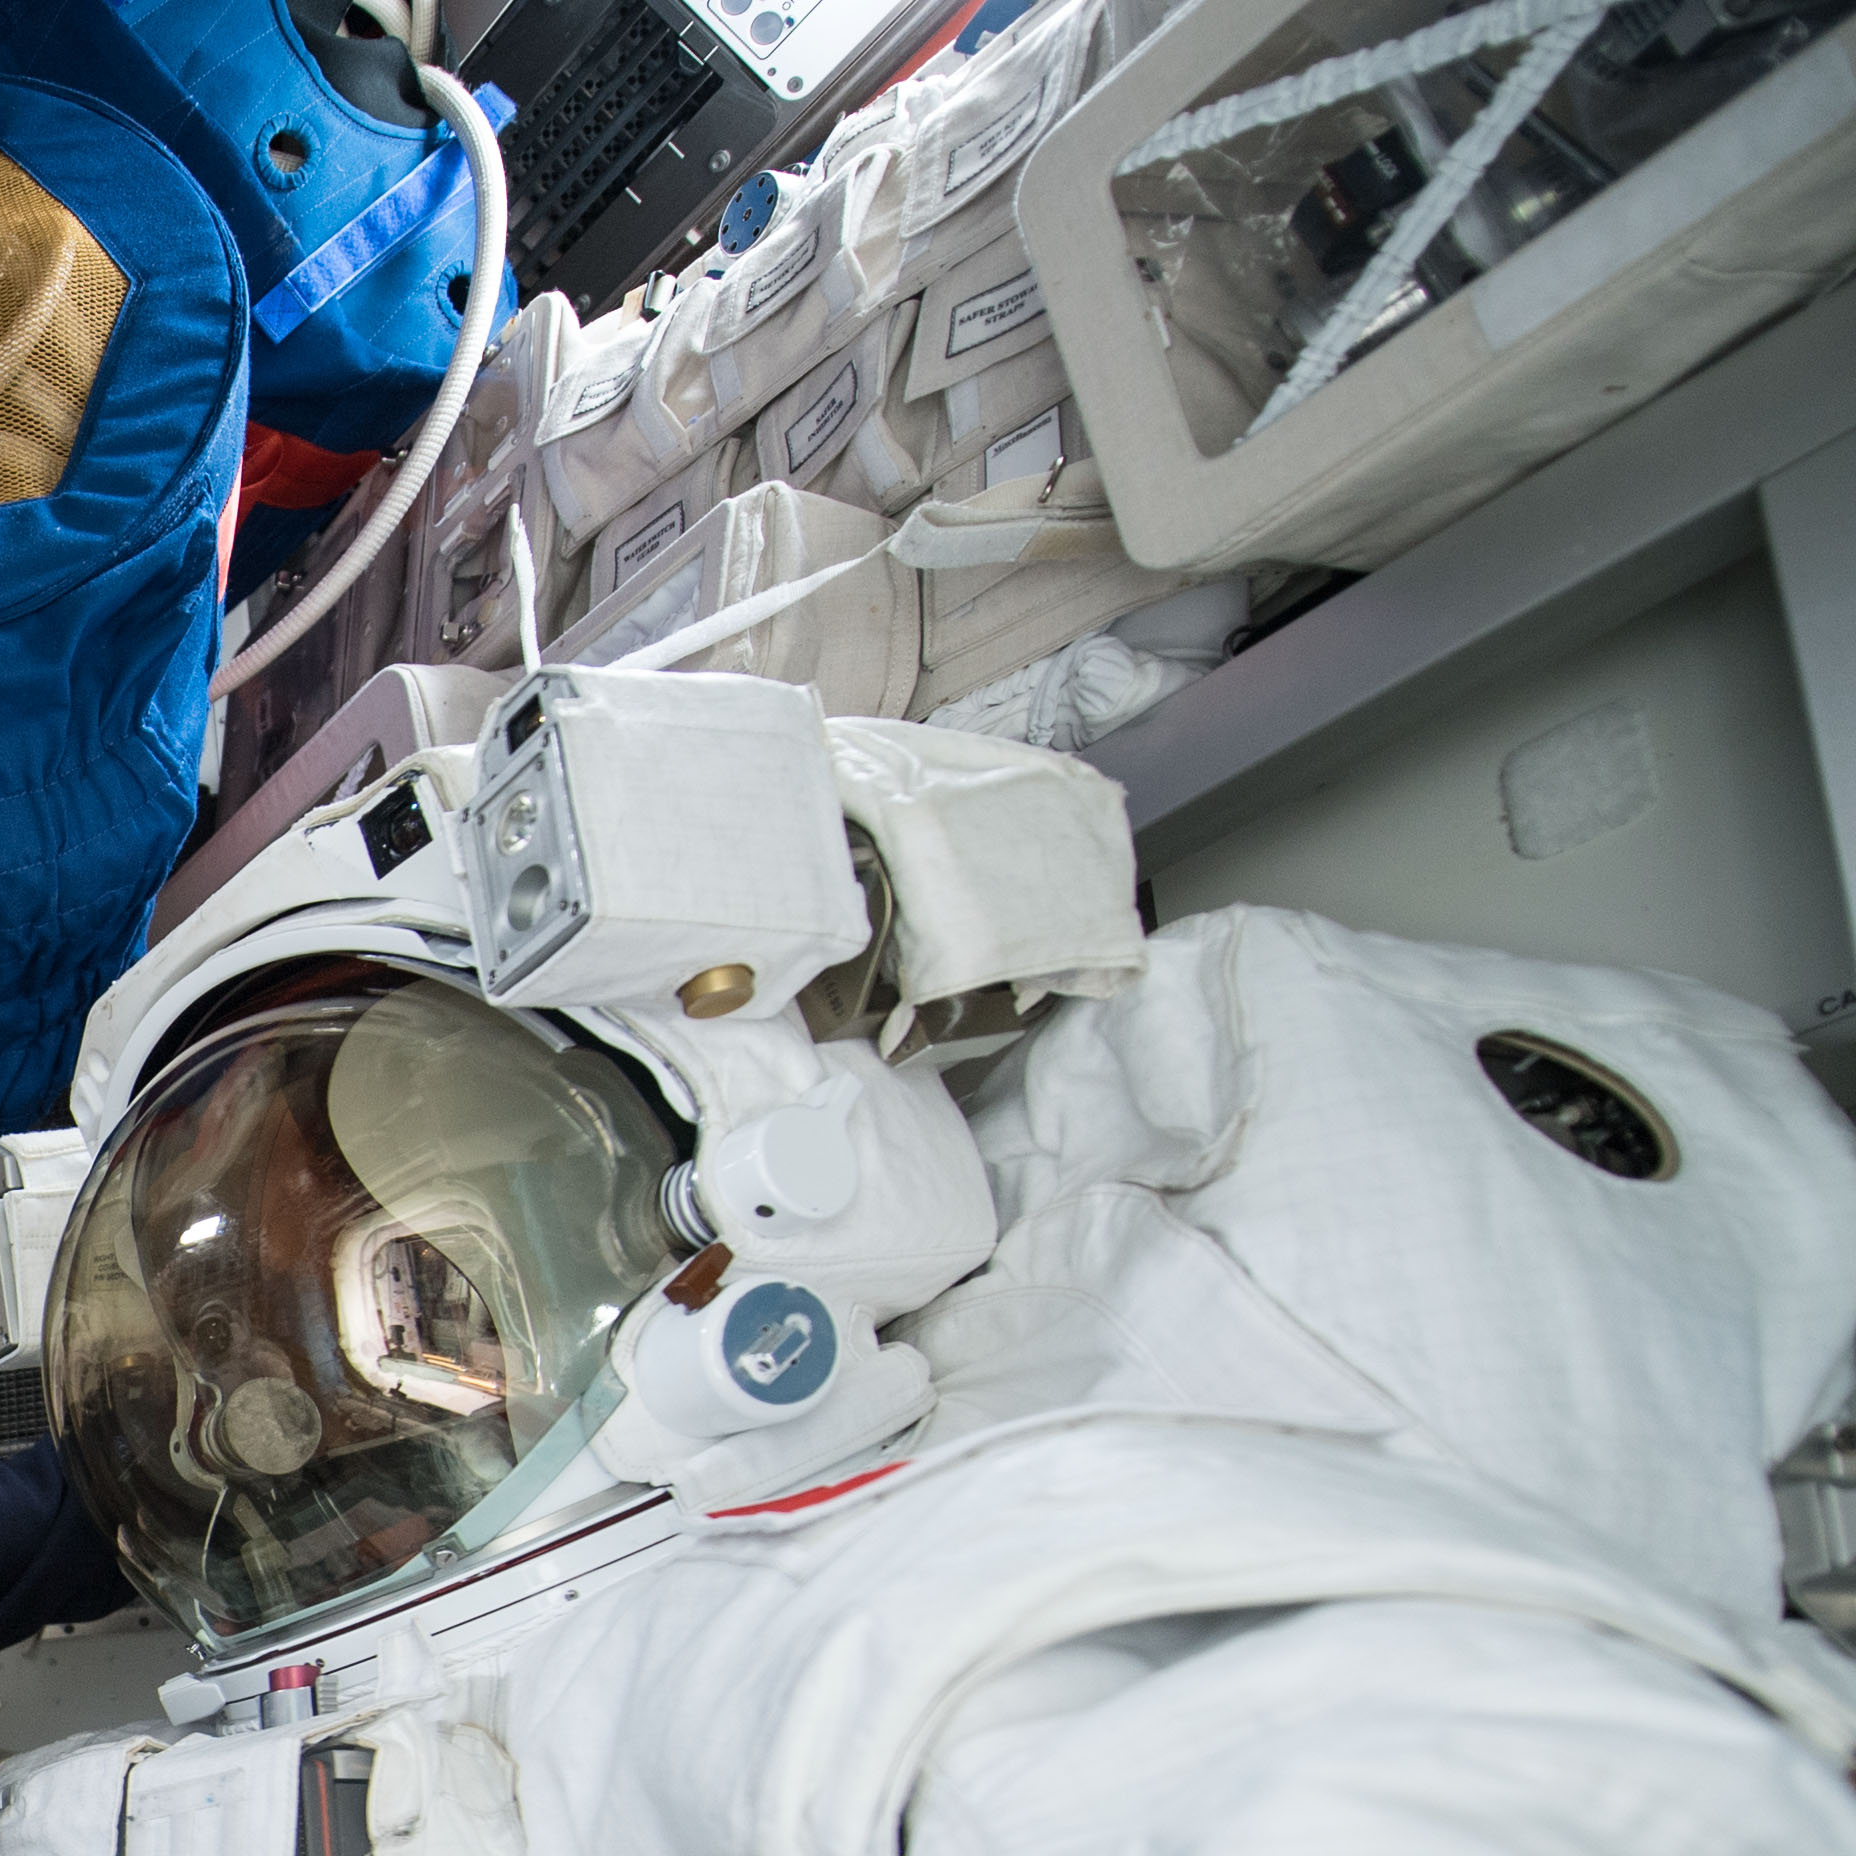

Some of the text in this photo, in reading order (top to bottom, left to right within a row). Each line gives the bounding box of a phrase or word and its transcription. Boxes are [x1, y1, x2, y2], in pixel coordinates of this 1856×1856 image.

[958, 304, 995, 326] SAFER
[984, 301, 1026, 327] STRAPS
[815, 397, 837, 425] SAFER
